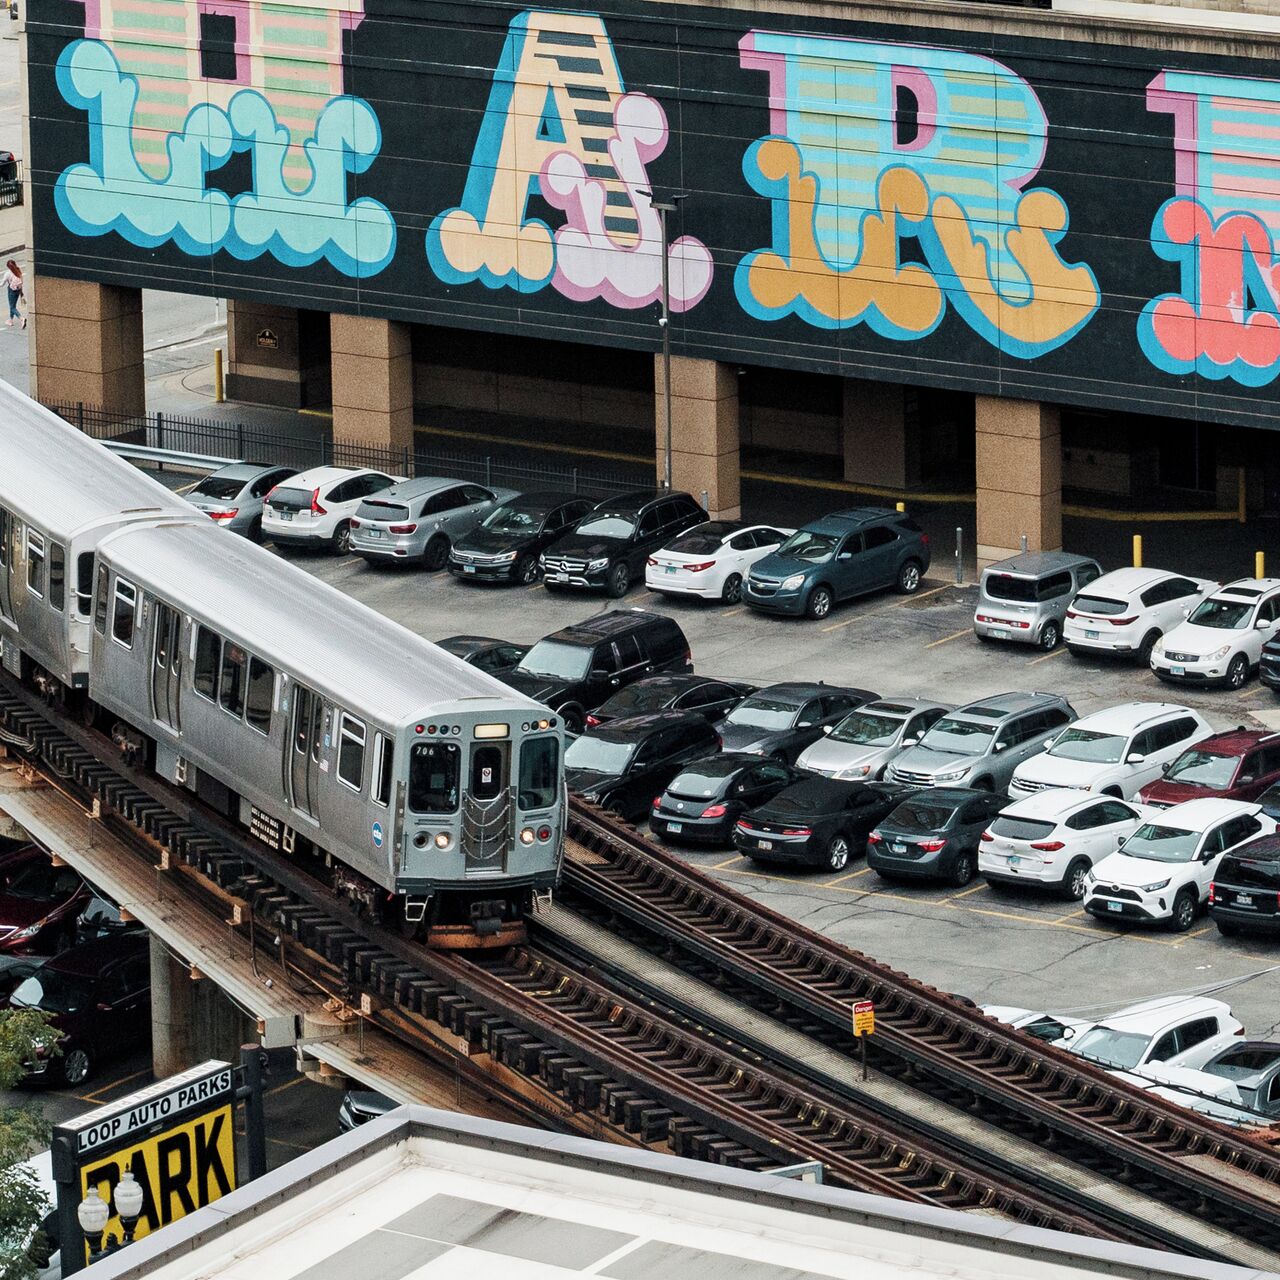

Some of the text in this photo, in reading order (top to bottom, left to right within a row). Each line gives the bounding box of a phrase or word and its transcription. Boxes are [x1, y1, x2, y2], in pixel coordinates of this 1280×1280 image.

[416, 746, 434, 756] 706
[78, 1072, 230, 1151] LOOP AUTO PARKS
[86, 1113, 232, 1232] PARK
